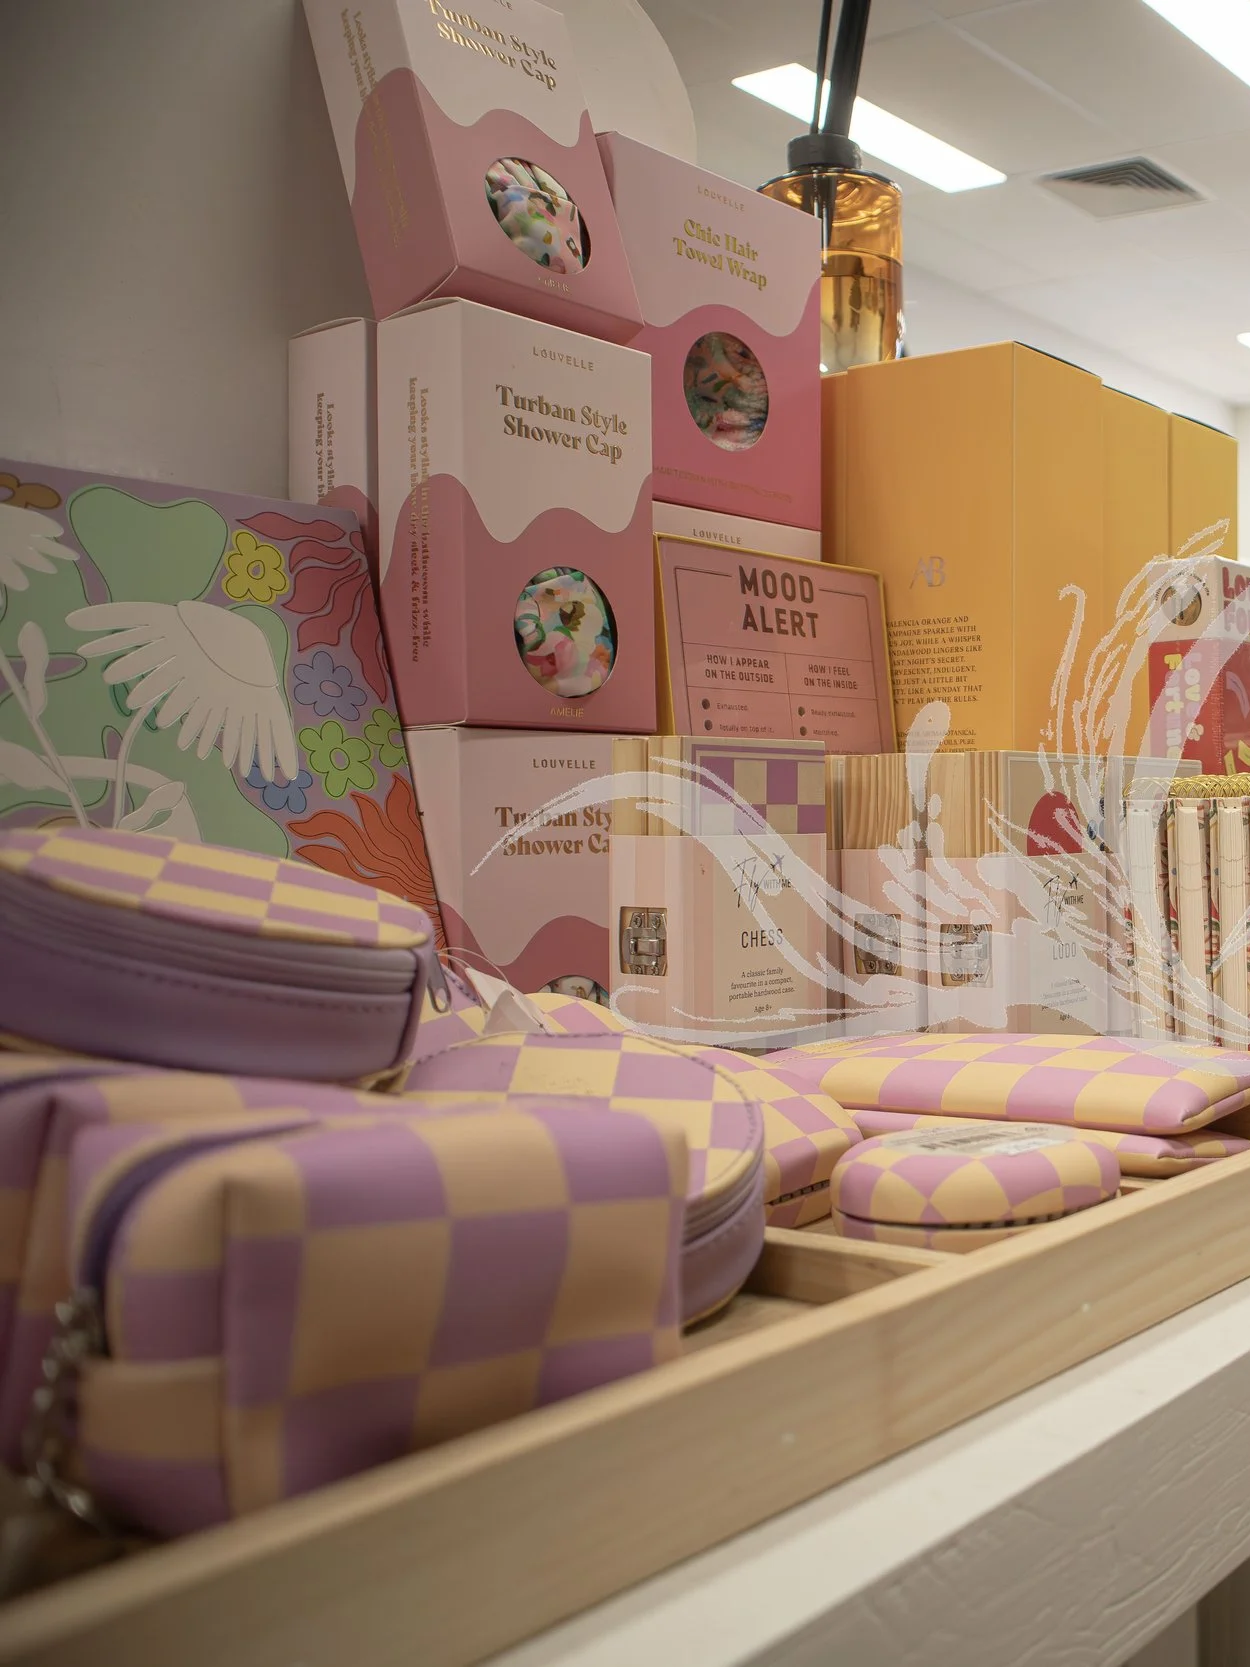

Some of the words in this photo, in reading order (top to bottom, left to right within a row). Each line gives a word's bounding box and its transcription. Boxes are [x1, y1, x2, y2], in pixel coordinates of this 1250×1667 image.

[426, 0, 506, 44] Turban
[510, 34, 557, 71] Style
[436, 21, 516, 68] Shower
[520, 59, 557, 92] Cap
[684, 219, 720, 247] Chic
[725, 233, 758, 261] Hair
[673, 237, 722, 271] Towel
[726, 256, 767, 291] Wrap
[533, 346, 594, 371] LOUVELLE
[495, 384, 576, 422] Turban
[581, 405, 627, 436] Style
[315, 392, 325, 447] keeping
[326, 403, 335, 446] Looks
[503, 414, 581, 449] Shower
[586, 433, 622, 465] Cap
[316, 449, 324, 481] your
[692, 528, 741, 545] LOUVELLE
[738, 565, 814, 604] MOOD
[742, 604, 819, 638] ALERT
[921, 616, 952, 626] ORANGE
[954, 615, 969, 624] AND
[923, 626, 955, 635] SPARKLE
[956, 624, 977, 633] WITH
[916, 637, 939, 646] WHILE
[948, 635, 981, 643] WHISPER
[933, 645, 964, 654] LINGERS
[965, 644, 982, 653] LIKE
[707, 654, 727, 665] HOW
[736, 658, 770, 669] APPEAR
[892, 659, 905, 667] AST
[906, 657, 936, 665] NIGHT'S
[705, 669, 718, 679] ON
[720, 670, 736, 681] THE
[738, 672, 774, 684] OUTSIDE
[808, 664, 826, 674] HOW
[833, 666, 851, 676] FEEL
[933, 665, 977, 674] INDULGENT,
[804, 677, 815, 687] ON
[817, 678, 831, 688] THE
[833, 679, 858, 690] INSIDE
[928, 676, 954, 684] LITTLE
[908, 687, 924, 695] LIKE
[932, 685, 962, 693] SUNDAY
[963, 684, 983, 692] THAT
[908, 697, 925, 705] PLAY
[953, 695, 978, 703] RULES.
[550, 706, 584, 718] AMELIE
[533, 758, 596, 769] LOUVELLE
[583, 805, 612, 832] Sty
[503, 834, 584, 856] Shower
[587, 833, 610, 854] Ca
[763, 879, 781, 889] WITH
[781, 878, 791, 889] ME
[1064, 896, 1076, 906] WITH
[1077, 895, 1084, 904] ME
[741, 928, 783, 948] CHESS
[747, 969, 766, 978] classic
[766, 967, 784, 976] family
[731, 981, 757, 990] favourite
[728, 990, 753, 1002] portable
[754, 987, 781, 998] hardwood
[754, 1005, 765, 1013] Age
